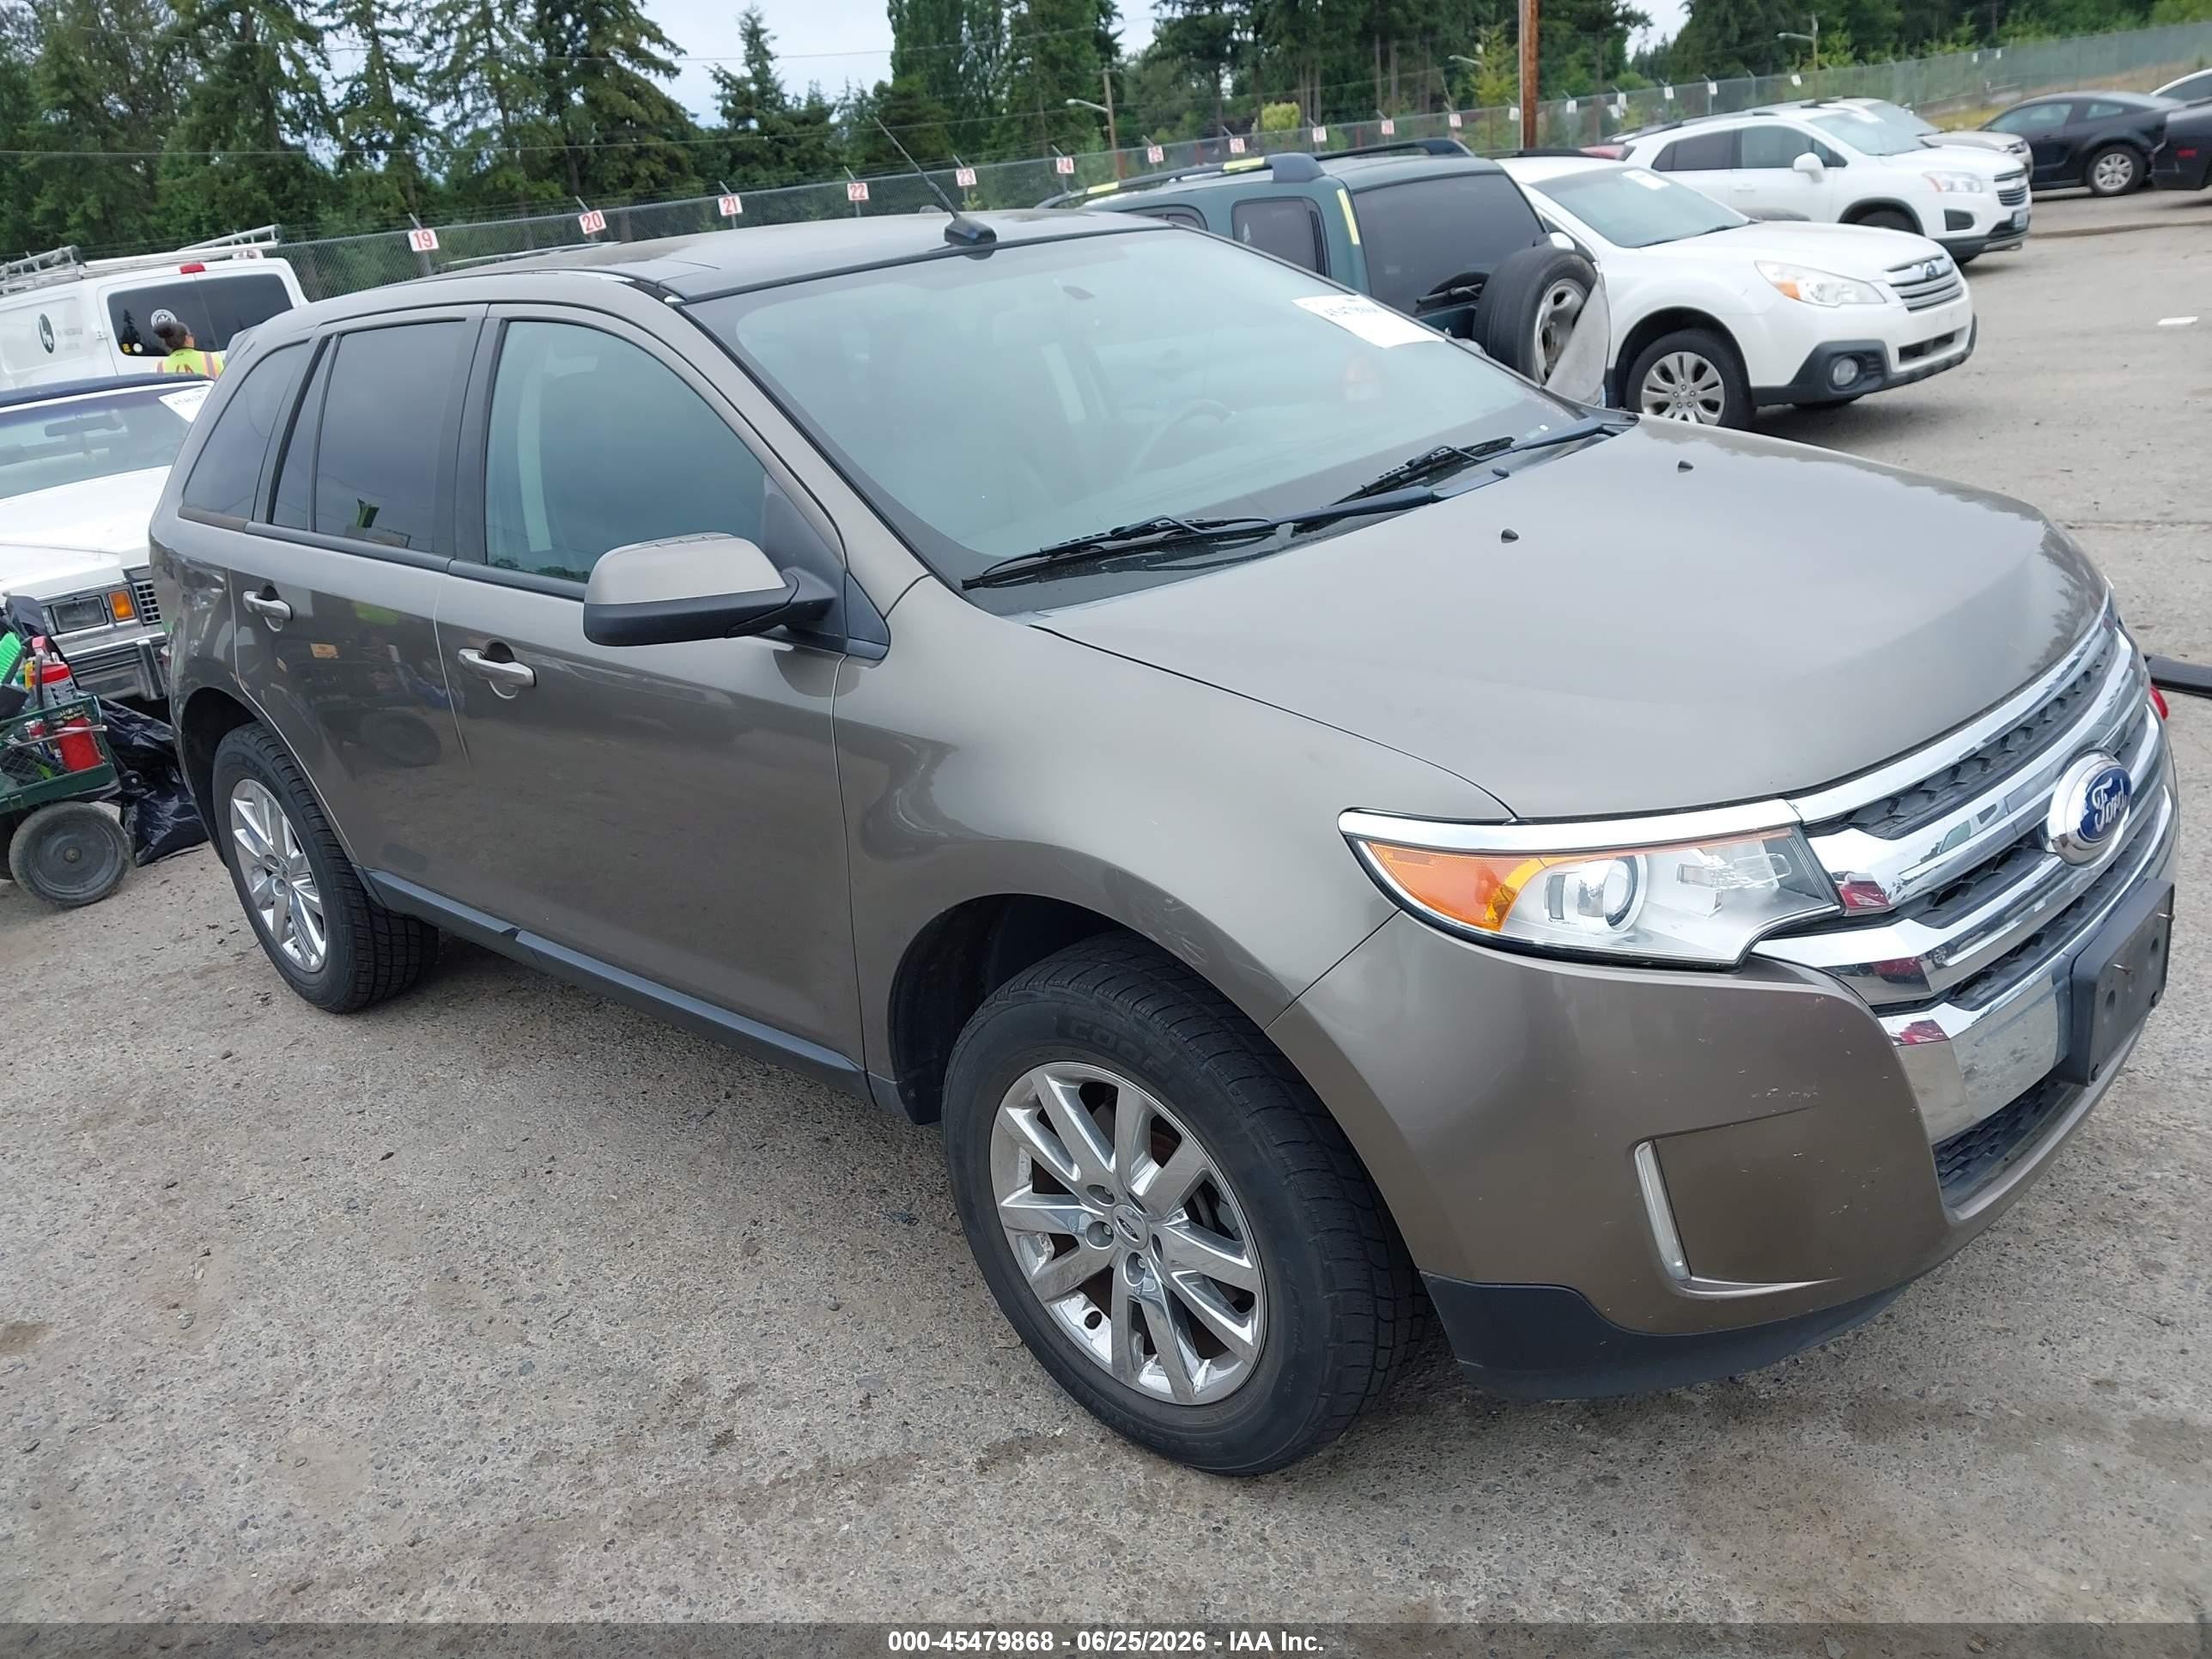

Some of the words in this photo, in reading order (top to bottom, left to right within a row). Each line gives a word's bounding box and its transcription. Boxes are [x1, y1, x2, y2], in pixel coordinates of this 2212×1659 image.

[1058, 158, 1073, 173] 24
[959, 170, 975, 185] 23
[850, 184, 866, 199] 22
[722, 197, 739, 214] 21
[582, 212, 603, 231] 20
[414, 232, 434, 249] 19
[2092, 776, 2127, 832] Ford
